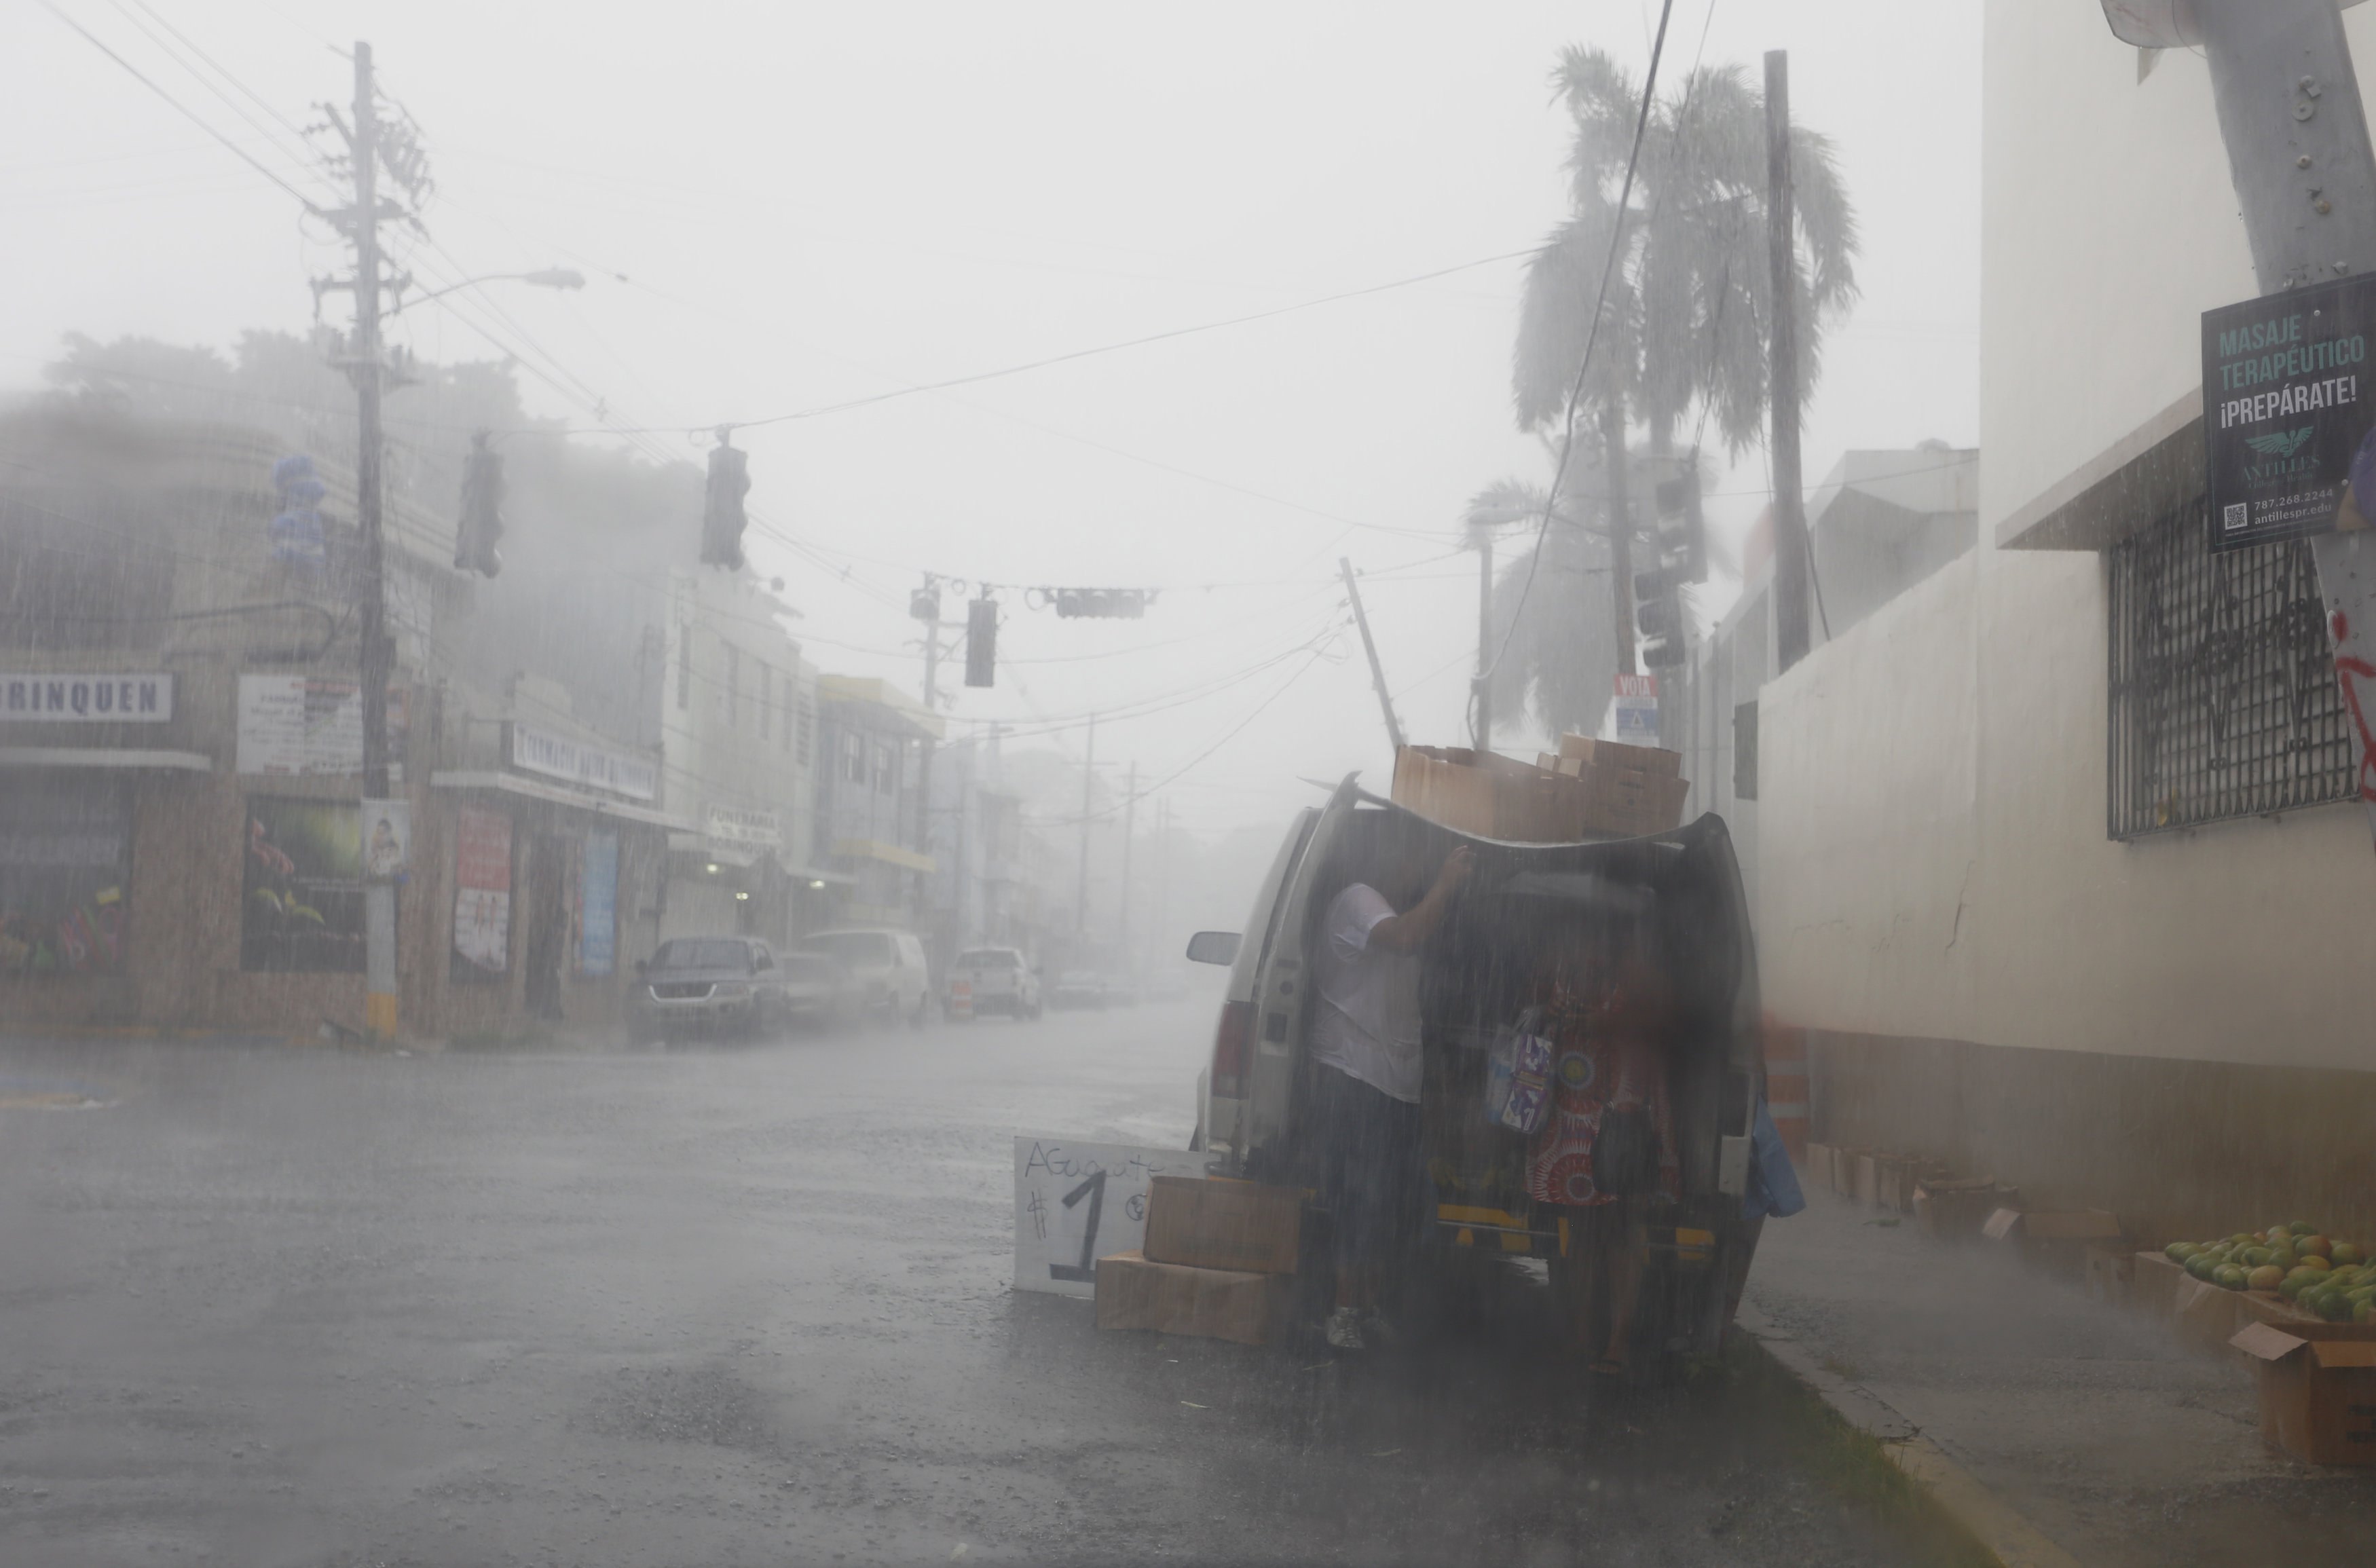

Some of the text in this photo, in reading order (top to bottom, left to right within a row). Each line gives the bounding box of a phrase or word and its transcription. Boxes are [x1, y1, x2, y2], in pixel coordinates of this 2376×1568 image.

[2220, 314, 2302, 358] MASAJE
[2220, 335, 2365, 391] TERAPÉUTICO
[2221, 375, 2357, 429] ¡PREPÁRATE!
[2254, 488, 2333, 511] 787.268.2244
[2254, 503, 2332, 525] antillespr.edu
[0, 681, 157, 716] RINQUEN
[1619, 675, 1652, 696] VOTA
[709, 807, 776, 829] FUNERARIA
